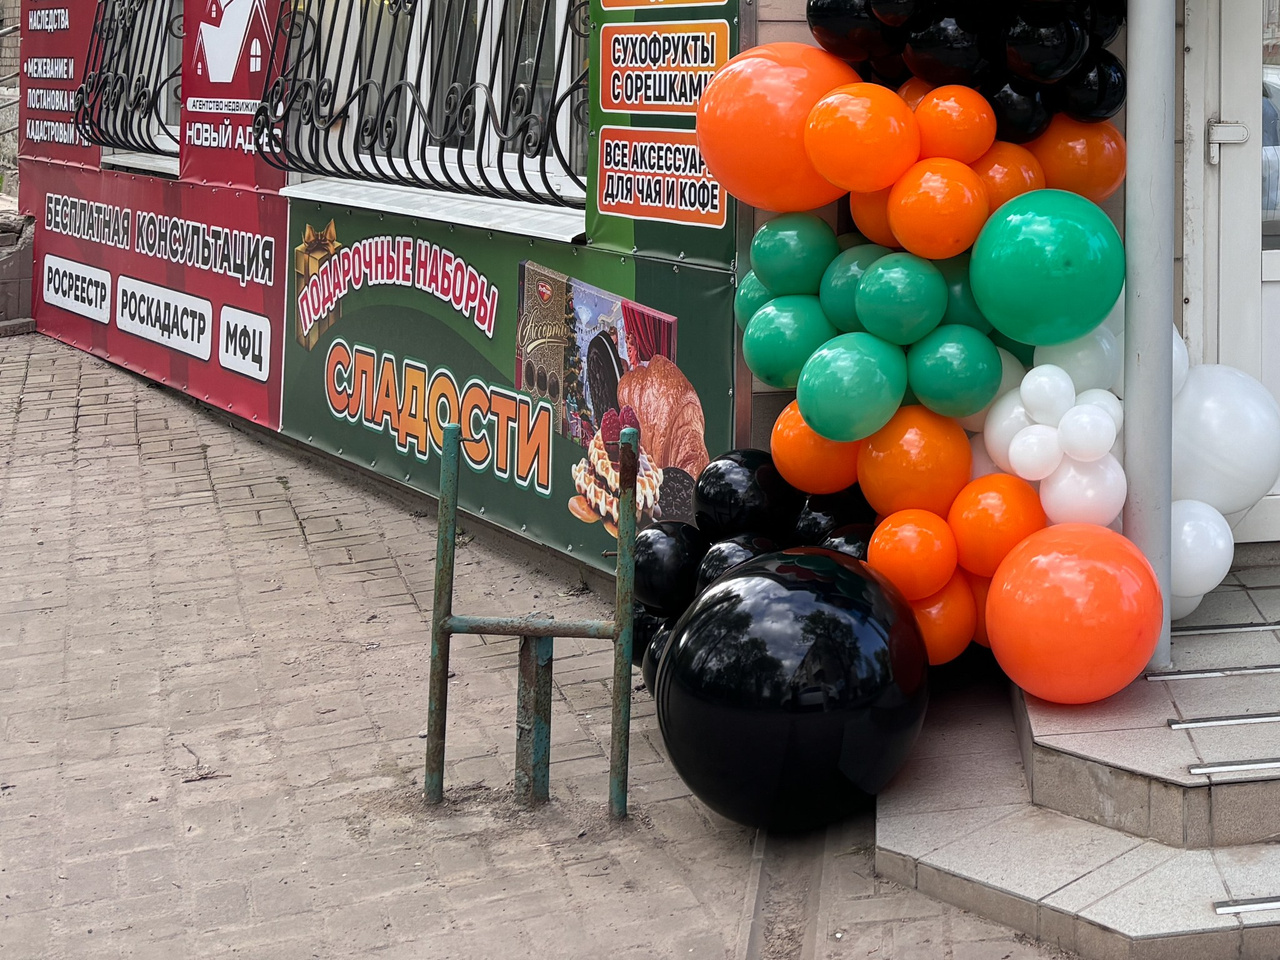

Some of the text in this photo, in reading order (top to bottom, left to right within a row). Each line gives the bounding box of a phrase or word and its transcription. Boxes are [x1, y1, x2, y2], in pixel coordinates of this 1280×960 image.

[28, 8, 69, 32] НАСЛЕДСТВА
[27, 57, 74, 79] МЕЖЕВАНИЕ И
[611, 31, 717, 70] СУХОФРУКТЫ
[27, 88, 68, 111] ПОСТАНОВКА
[191, 99, 223, 111] АГЕНТСТВО
[611, 71, 622, 104] С
[26, 118, 75, 144] КАДАСТРОВЫЙ
[186, 118, 282, 155] НОВЫЙ АДЕС
[603, 140, 714, 177] ВСЕ АКСЕССУАР
[603, 171, 720, 214] ДЛЯ ЧАЯ И КОФЕ
[45, 192, 275, 287] БЕСПЛАТНАЯ КОНСУЛЬТАЦИЯ
[298, 236, 499, 339] ПОДАРОЧНЫЕ НАБОРЫ
[46, 265, 264, 372] РОСРЕЕСТР РОСКАДАСТР МФЦ
[324, 337, 553, 496] СЛАДОСТИ
